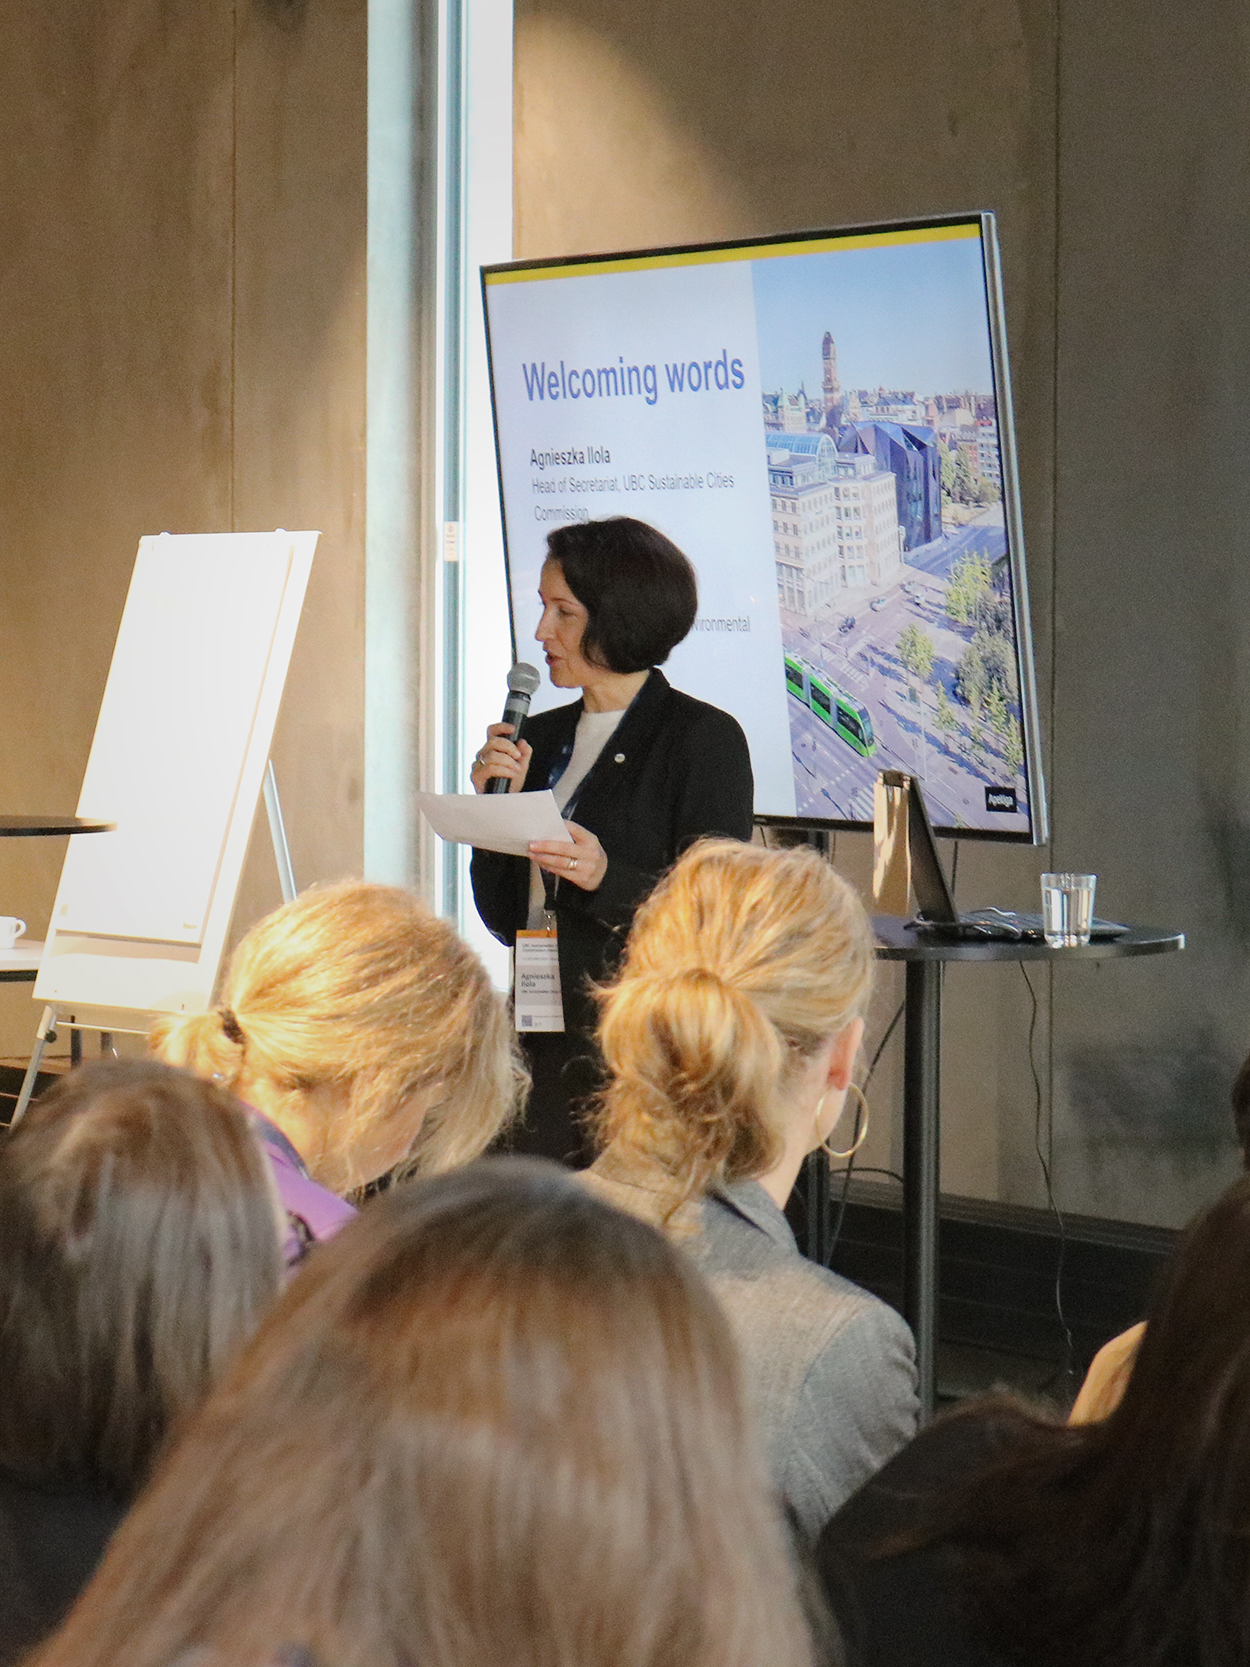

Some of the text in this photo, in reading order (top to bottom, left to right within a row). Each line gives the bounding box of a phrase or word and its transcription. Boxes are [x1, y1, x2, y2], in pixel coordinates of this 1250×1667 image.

[522, 348, 744, 405] Welcoming words
[530, 446, 611, 470] Agnieszka Ilola
[532, 471, 735, 494] Head of Secretariat, UBC Sustainable Cities
[534, 504, 589, 522] Commission
